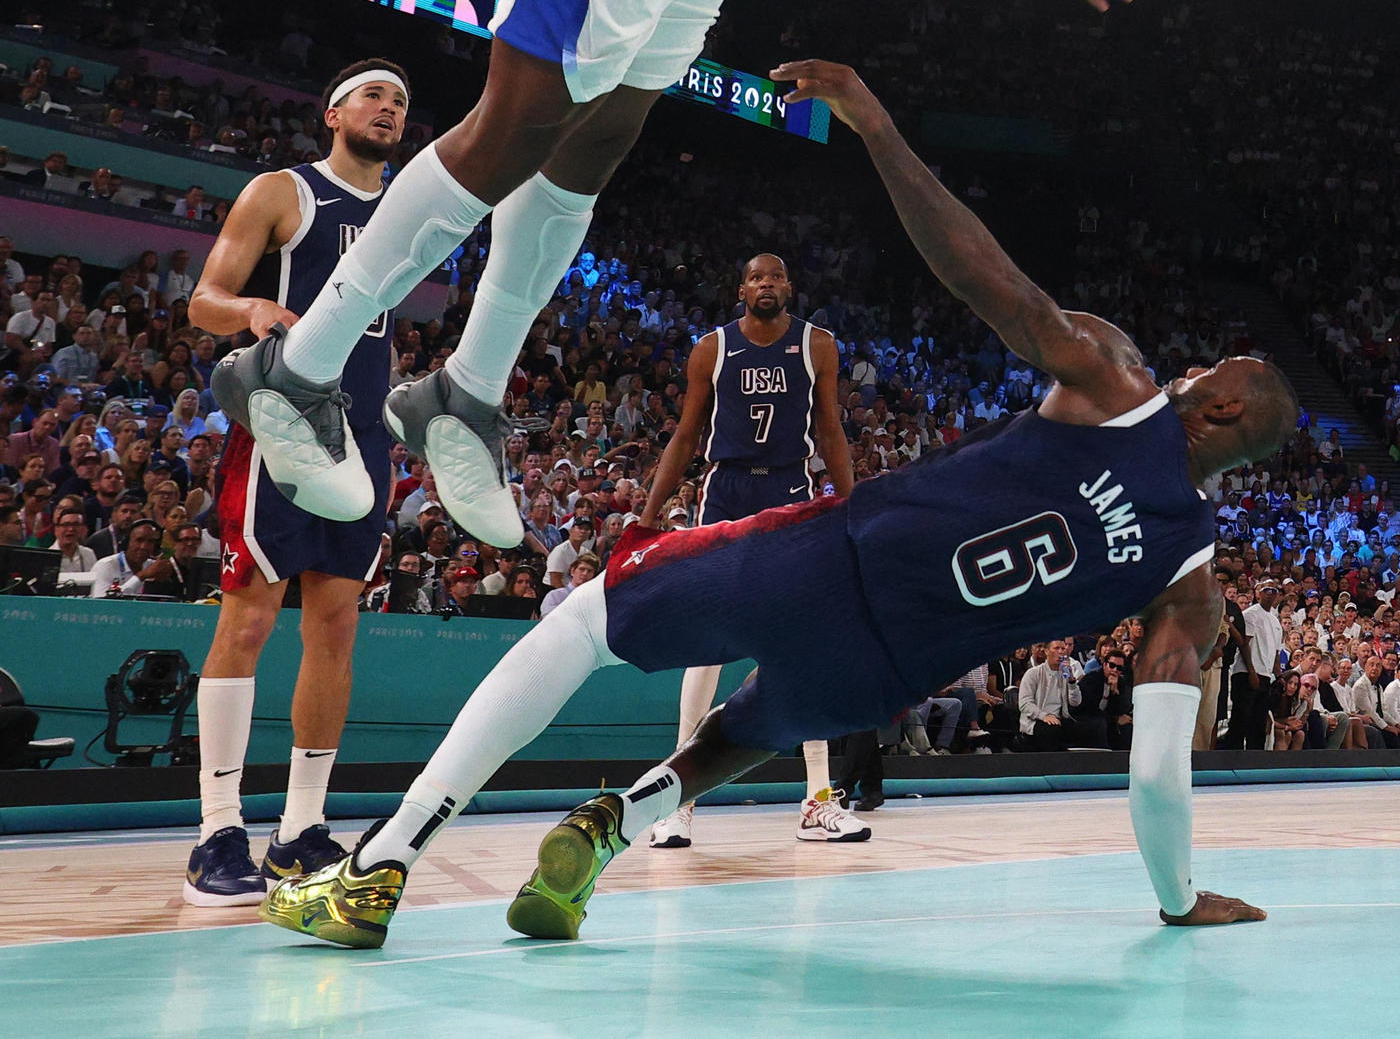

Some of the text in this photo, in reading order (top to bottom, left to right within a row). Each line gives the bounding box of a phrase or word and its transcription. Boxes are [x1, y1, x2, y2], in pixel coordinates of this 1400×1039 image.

[731, 82, 786, 118] 2024
[741, 366, 787, 395] USA
[750, 403, 774, 443] 7
[1079, 469, 1143, 564] JAMES
[952, 511, 1078, 606] 6
